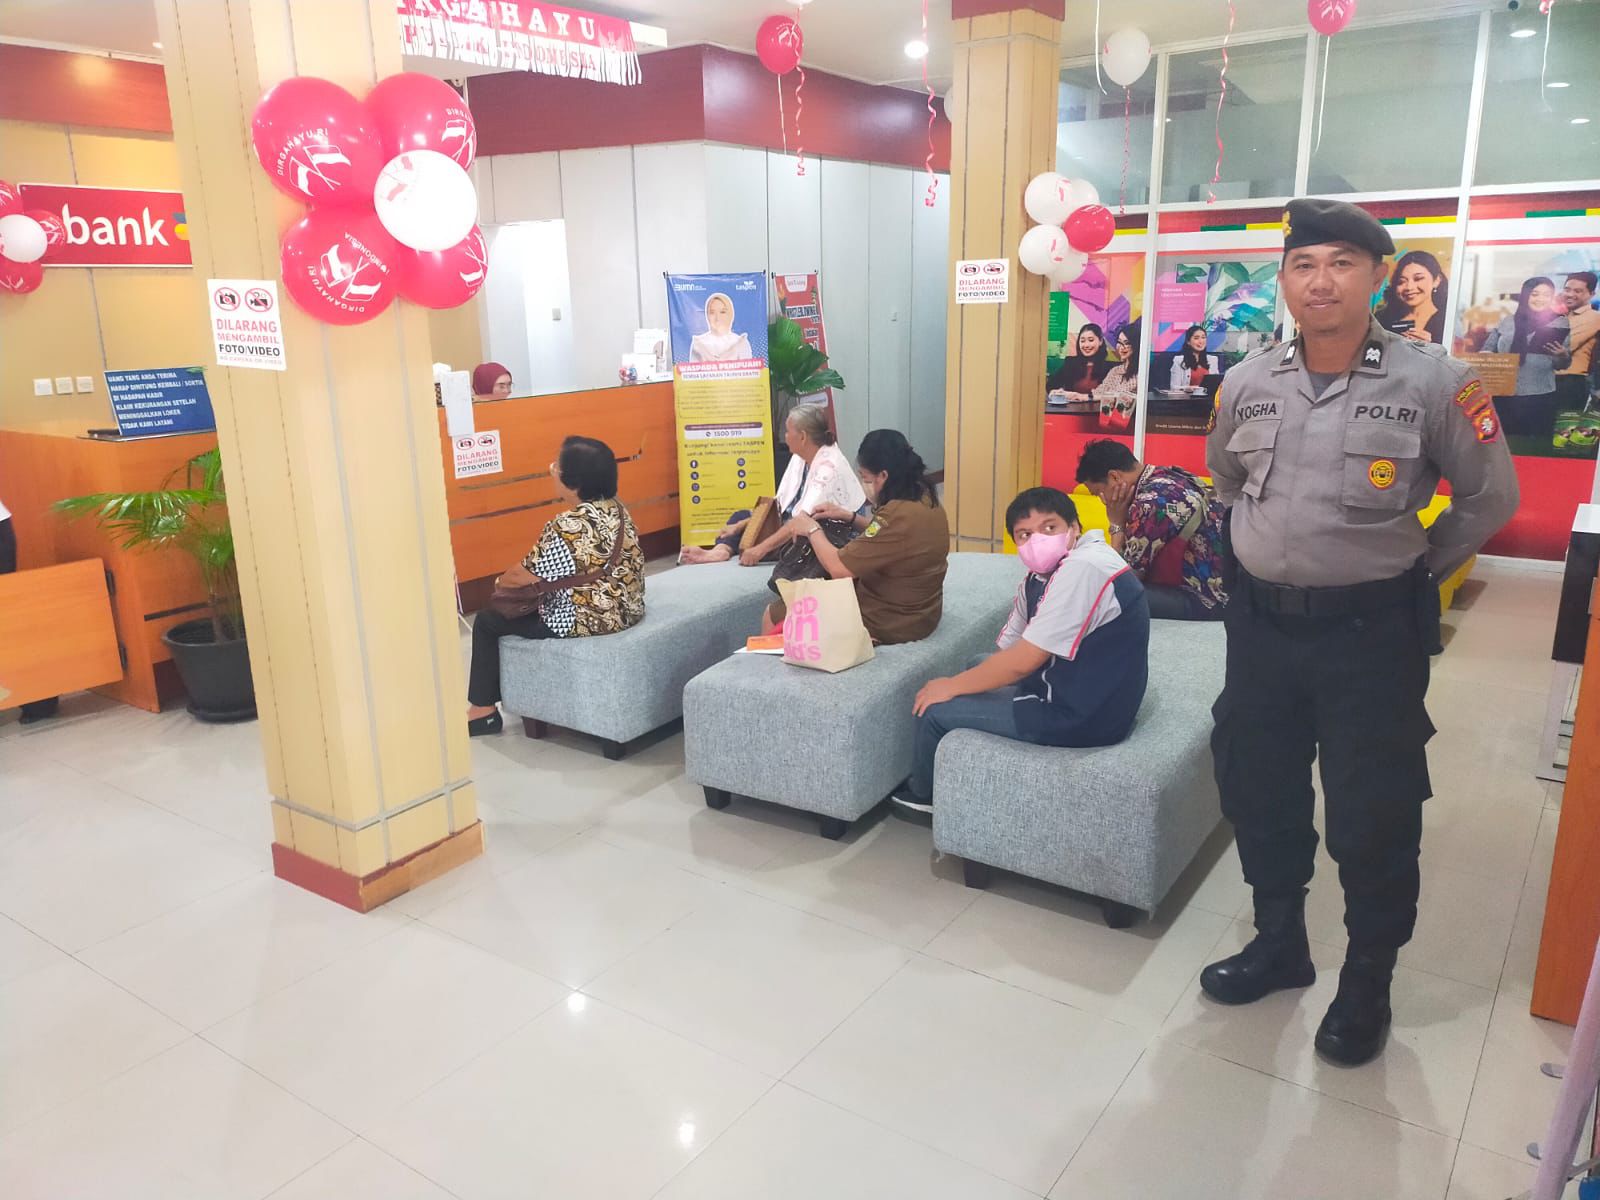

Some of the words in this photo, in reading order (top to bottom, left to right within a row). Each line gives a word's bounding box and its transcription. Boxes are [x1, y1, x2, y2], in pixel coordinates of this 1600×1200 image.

[61, 202, 170, 247] bank
[959, 278, 1005, 286] DILARANG
[216, 318, 277, 333] DILARANG
[217, 332, 280, 345] MENGAMBIL
[1236, 402, 1278, 421] YOGHA
[1354, 405, 1418, 424] POLRI
[456, 448, 498, 461] DILARANG
